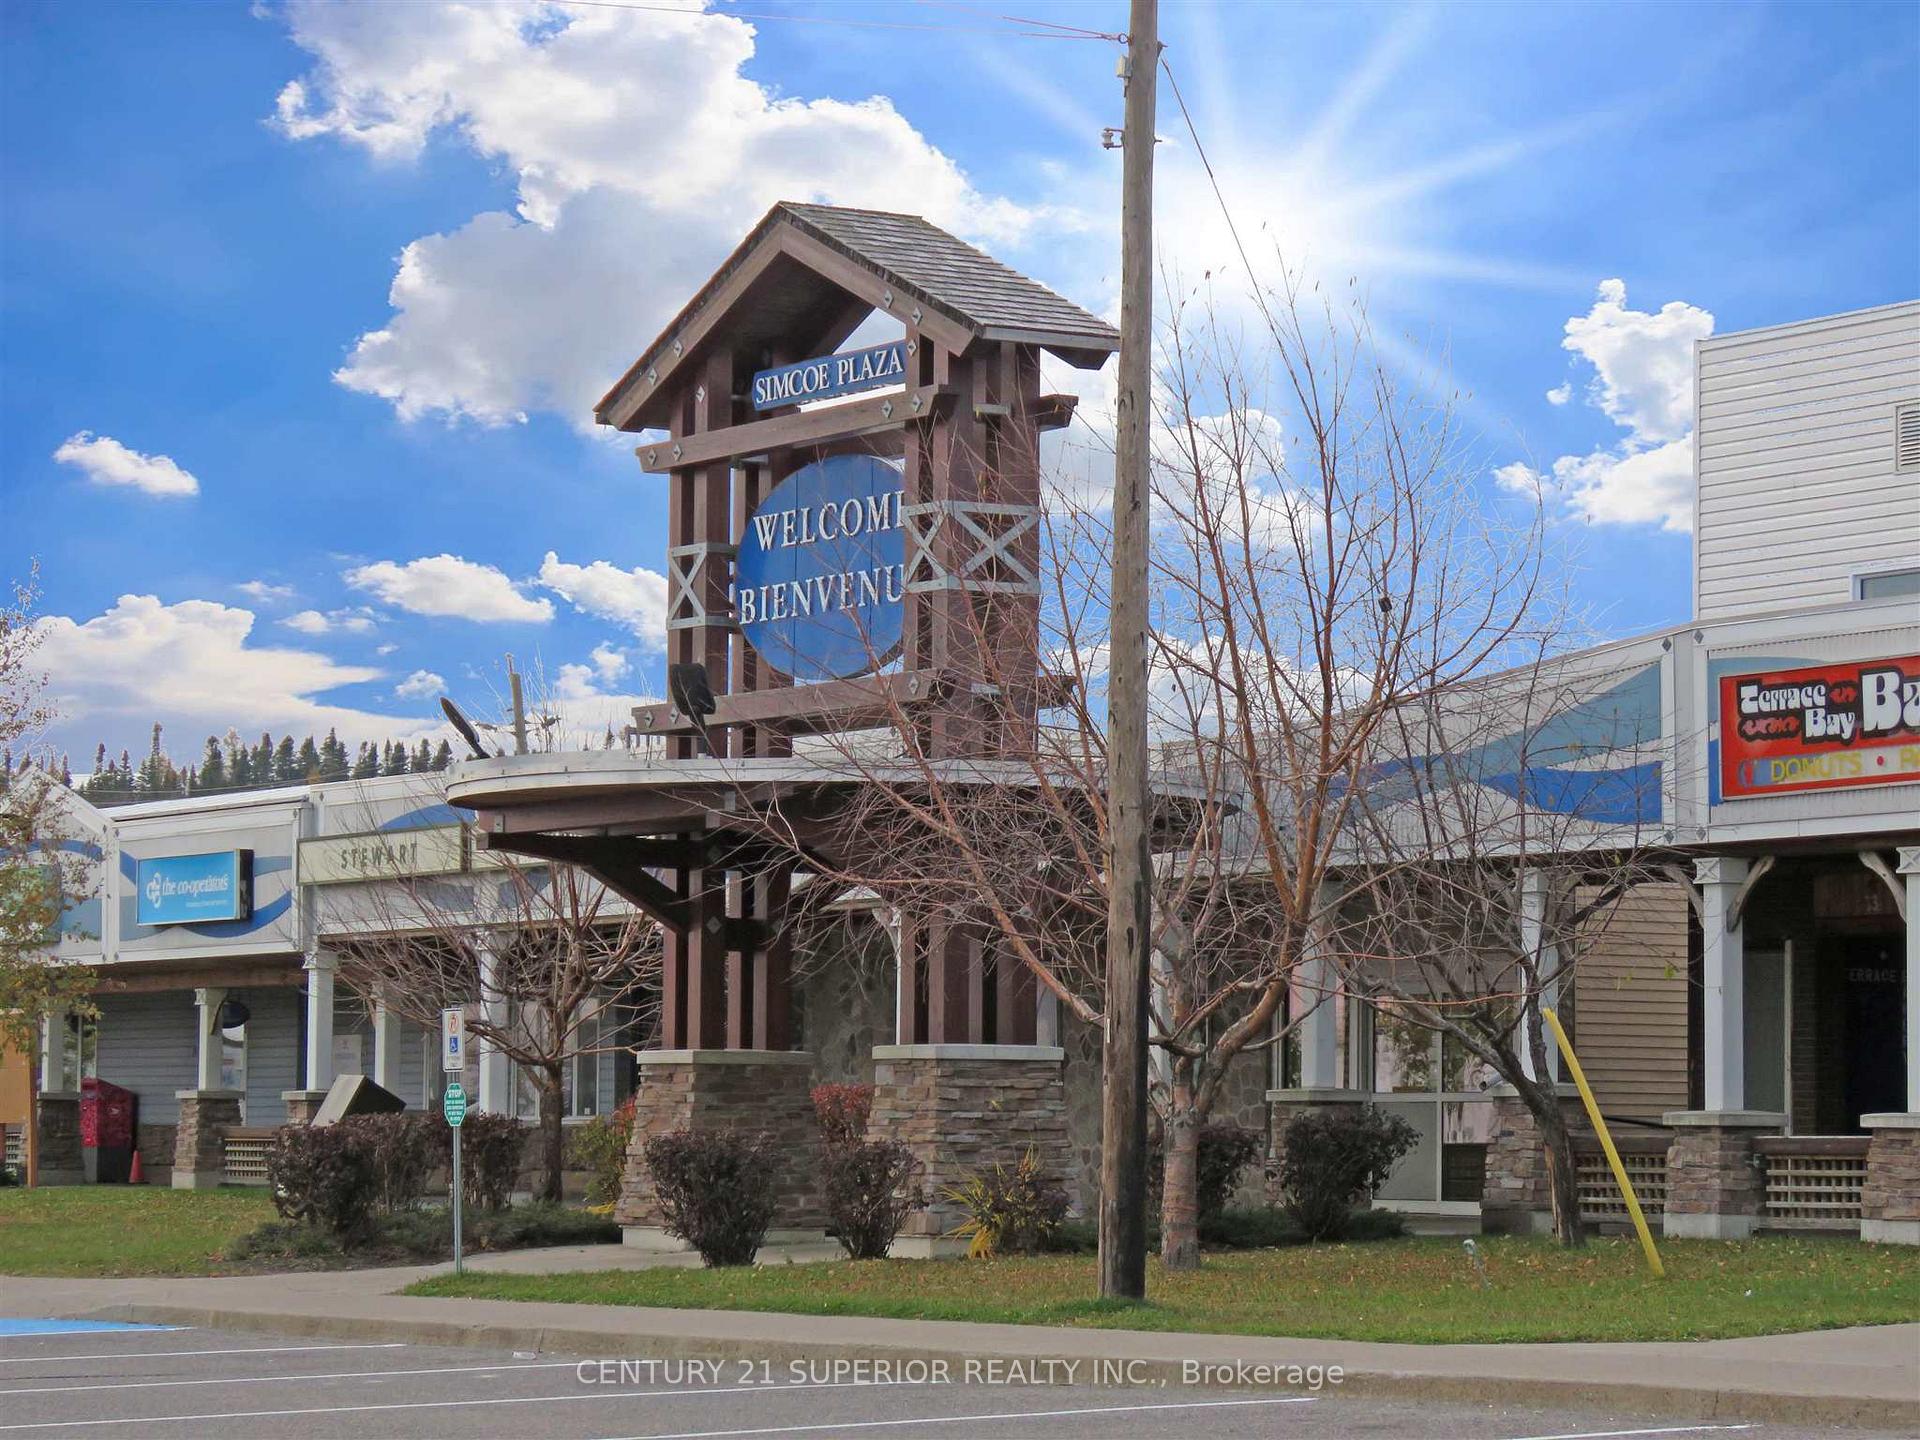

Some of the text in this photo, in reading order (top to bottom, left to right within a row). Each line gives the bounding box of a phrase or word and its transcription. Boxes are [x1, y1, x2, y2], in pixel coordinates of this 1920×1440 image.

[756, 346, 904, 404] SIMCOE PLAZA
[739, 565, 905, 624] BIENVENU
[1740, 684, 1826, 714] Terrace
[1804, 708, 1856, 740] Bay
[1771, 751, 1863, 782] DONUTS
[341, 842, 418, 869] STEWART
[163, 877, 176, 896] the
